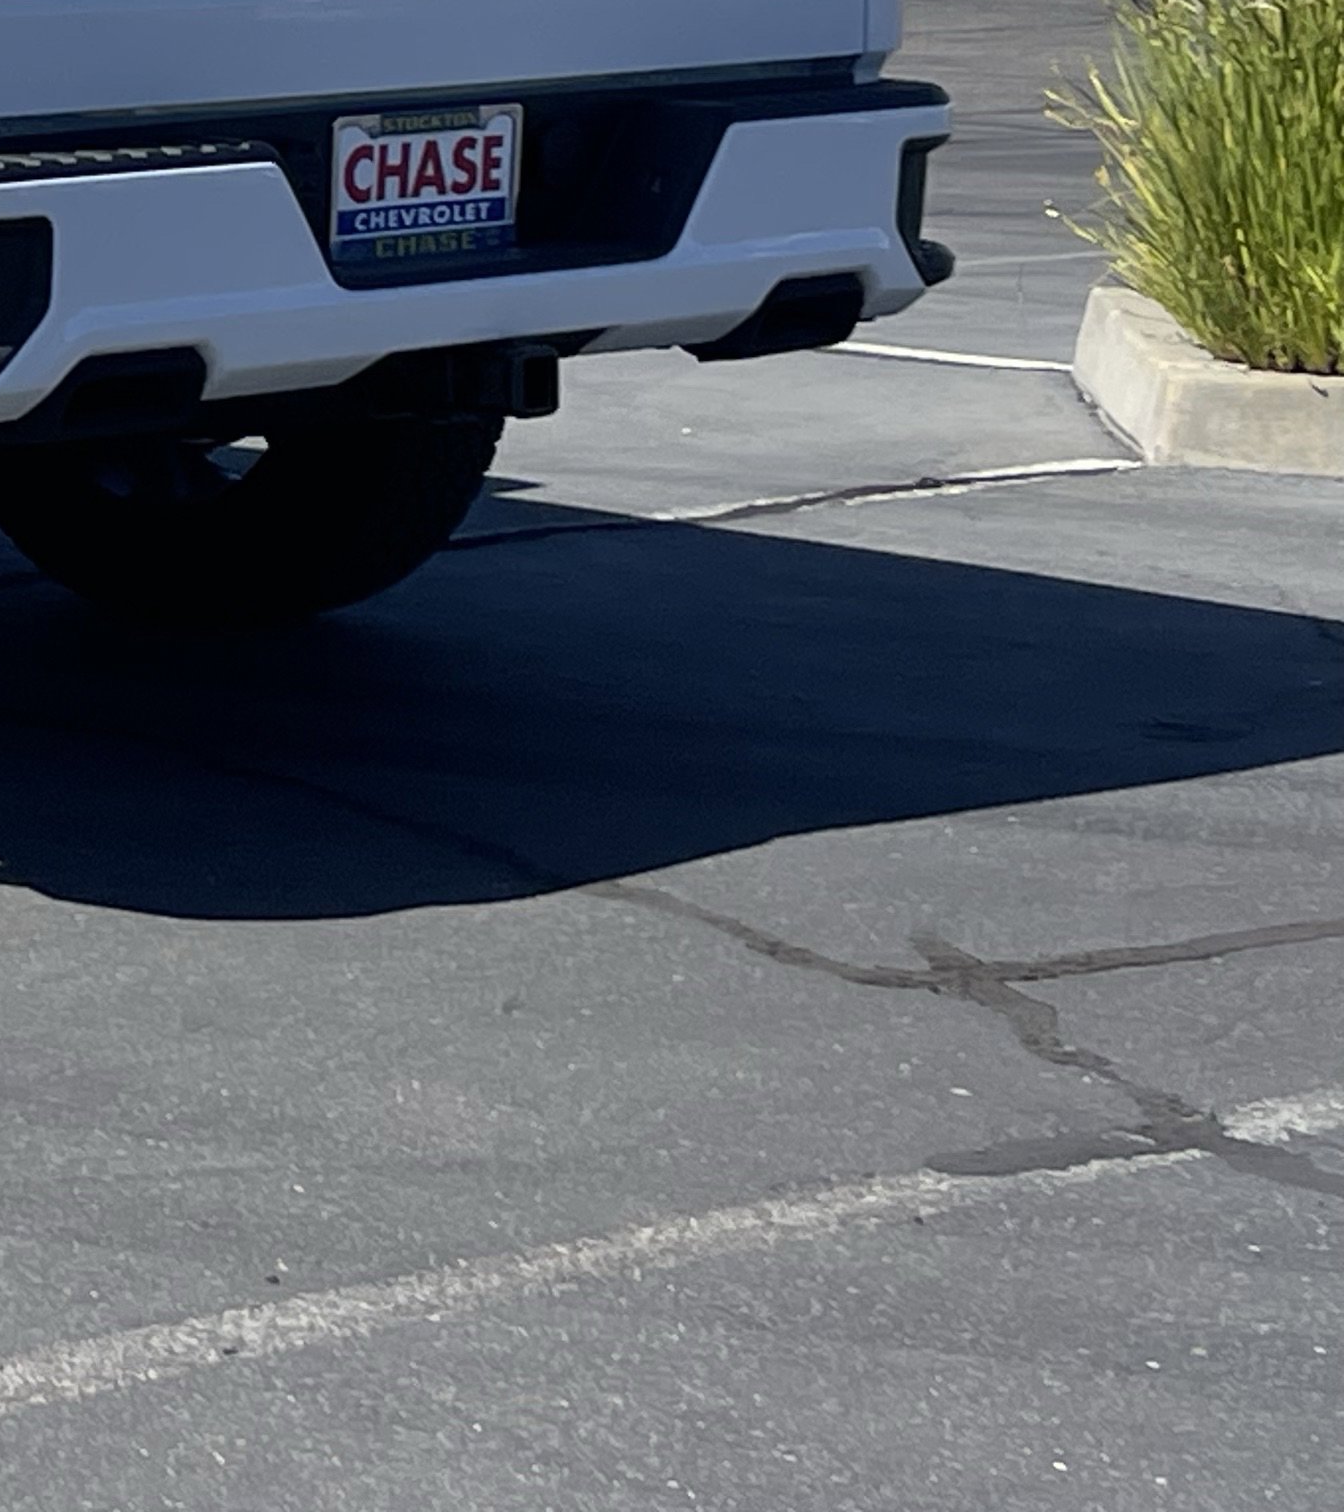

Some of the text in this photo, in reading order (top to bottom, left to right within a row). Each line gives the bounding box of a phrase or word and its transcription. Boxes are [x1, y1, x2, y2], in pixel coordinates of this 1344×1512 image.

[344, 135, 504, 204] CHASE
[354, 203, 491, 231] CHEVROLET
[375, 233, 477, 258] CHASE
